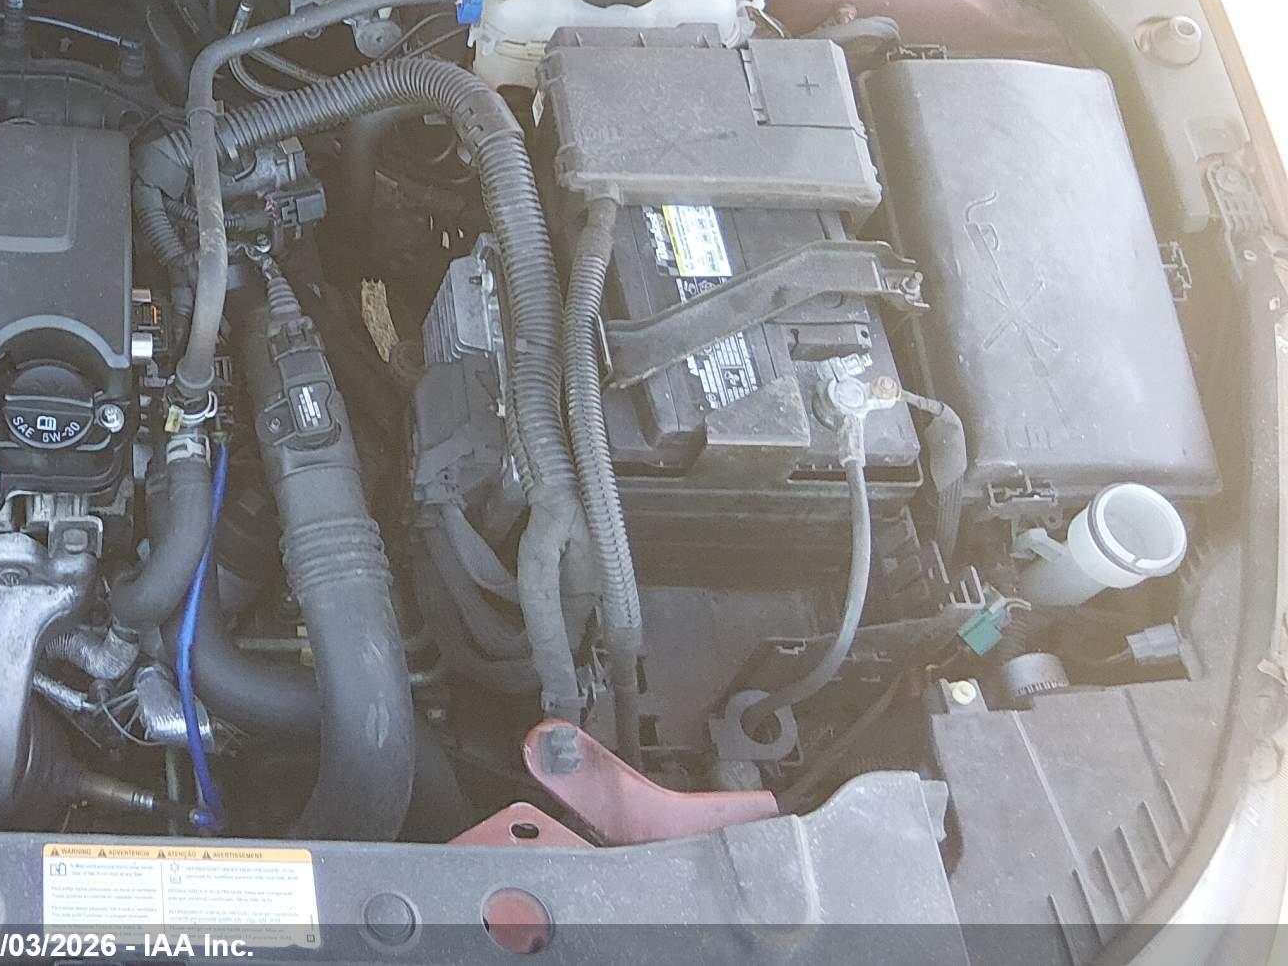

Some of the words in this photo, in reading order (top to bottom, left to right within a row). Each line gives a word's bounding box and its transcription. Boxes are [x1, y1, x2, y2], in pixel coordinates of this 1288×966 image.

[11, 415, 36, 439] SAE
[41, 420, 81, 443] 5W-30
[61, 848, 92, 856] WARNING
[108, 849, 150, 857] ADVERTENCIA
[167, 850, 197, 859] ATENÇÃO
[213, 851, 263, 859] AVERTISSEMENT
